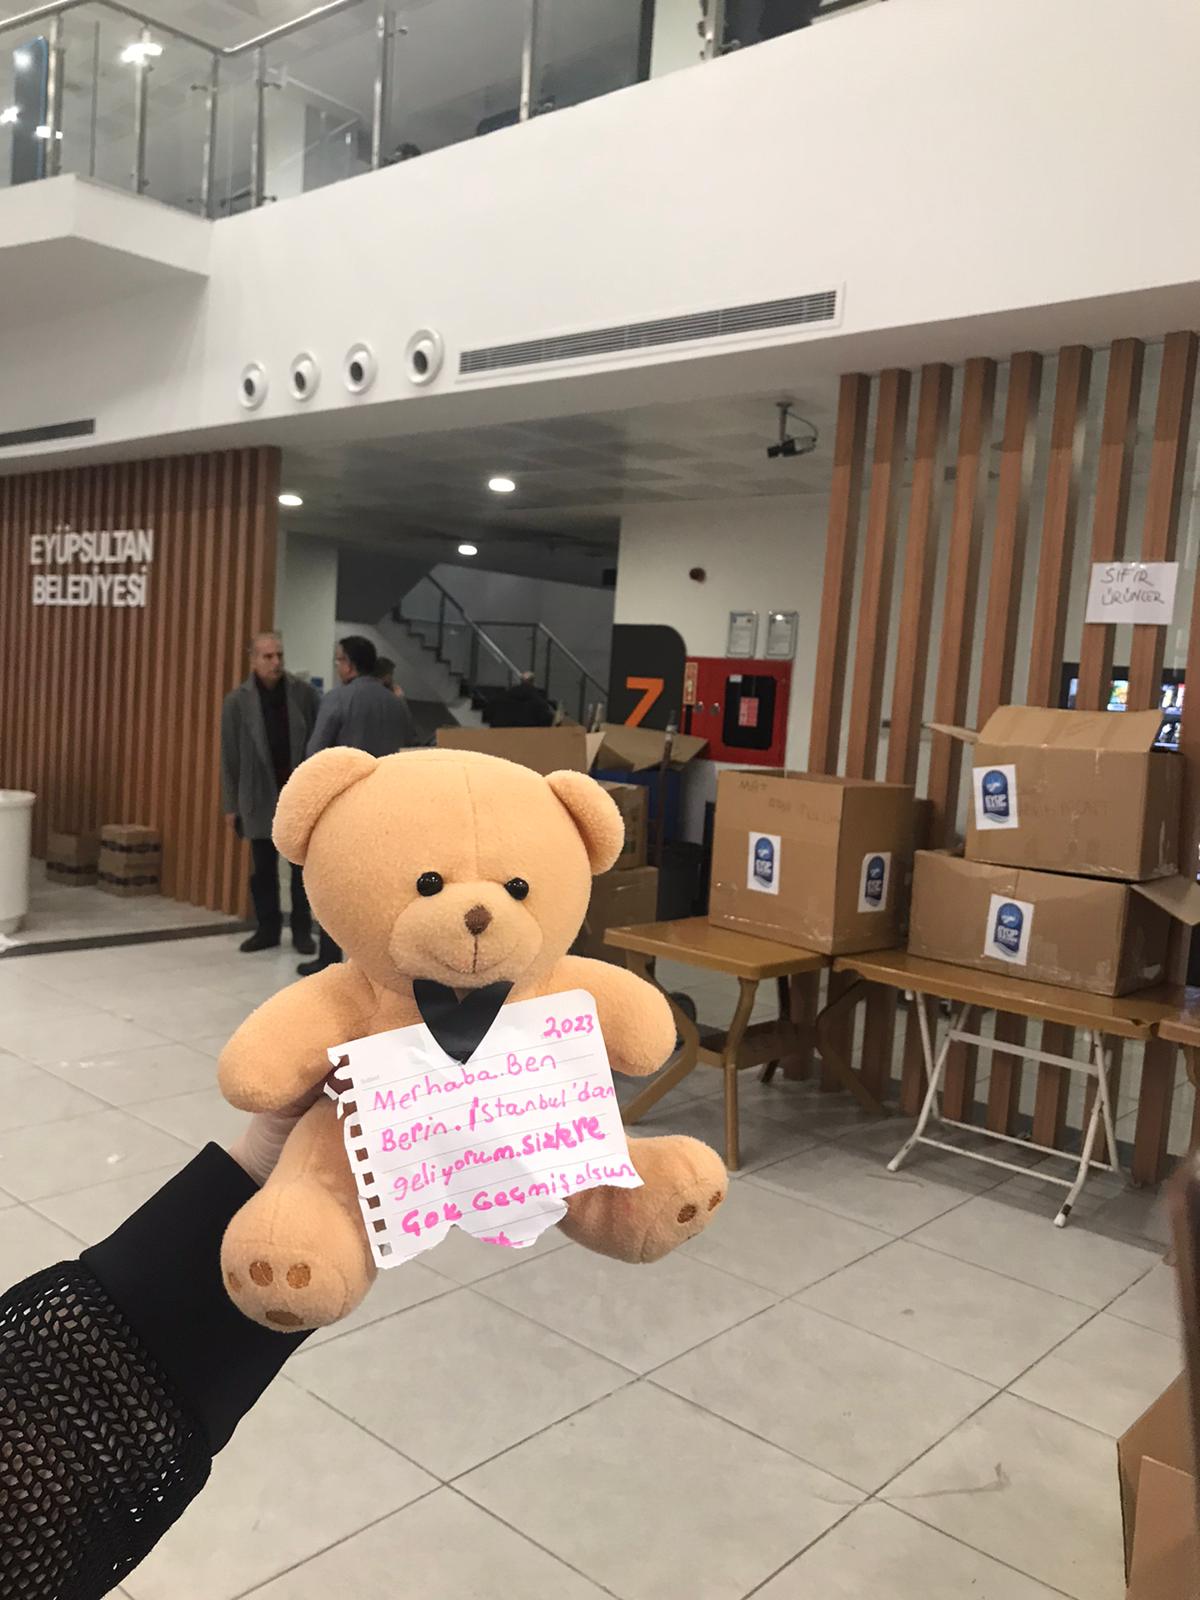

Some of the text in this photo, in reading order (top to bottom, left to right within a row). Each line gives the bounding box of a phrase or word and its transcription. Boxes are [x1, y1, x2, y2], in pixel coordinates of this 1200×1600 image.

[30, 524, 154, 565] EYÜPSULTAN
[32, 565, 148, 608] BELEDİYESİ
[543, 1014, 594, 1038] 2023
